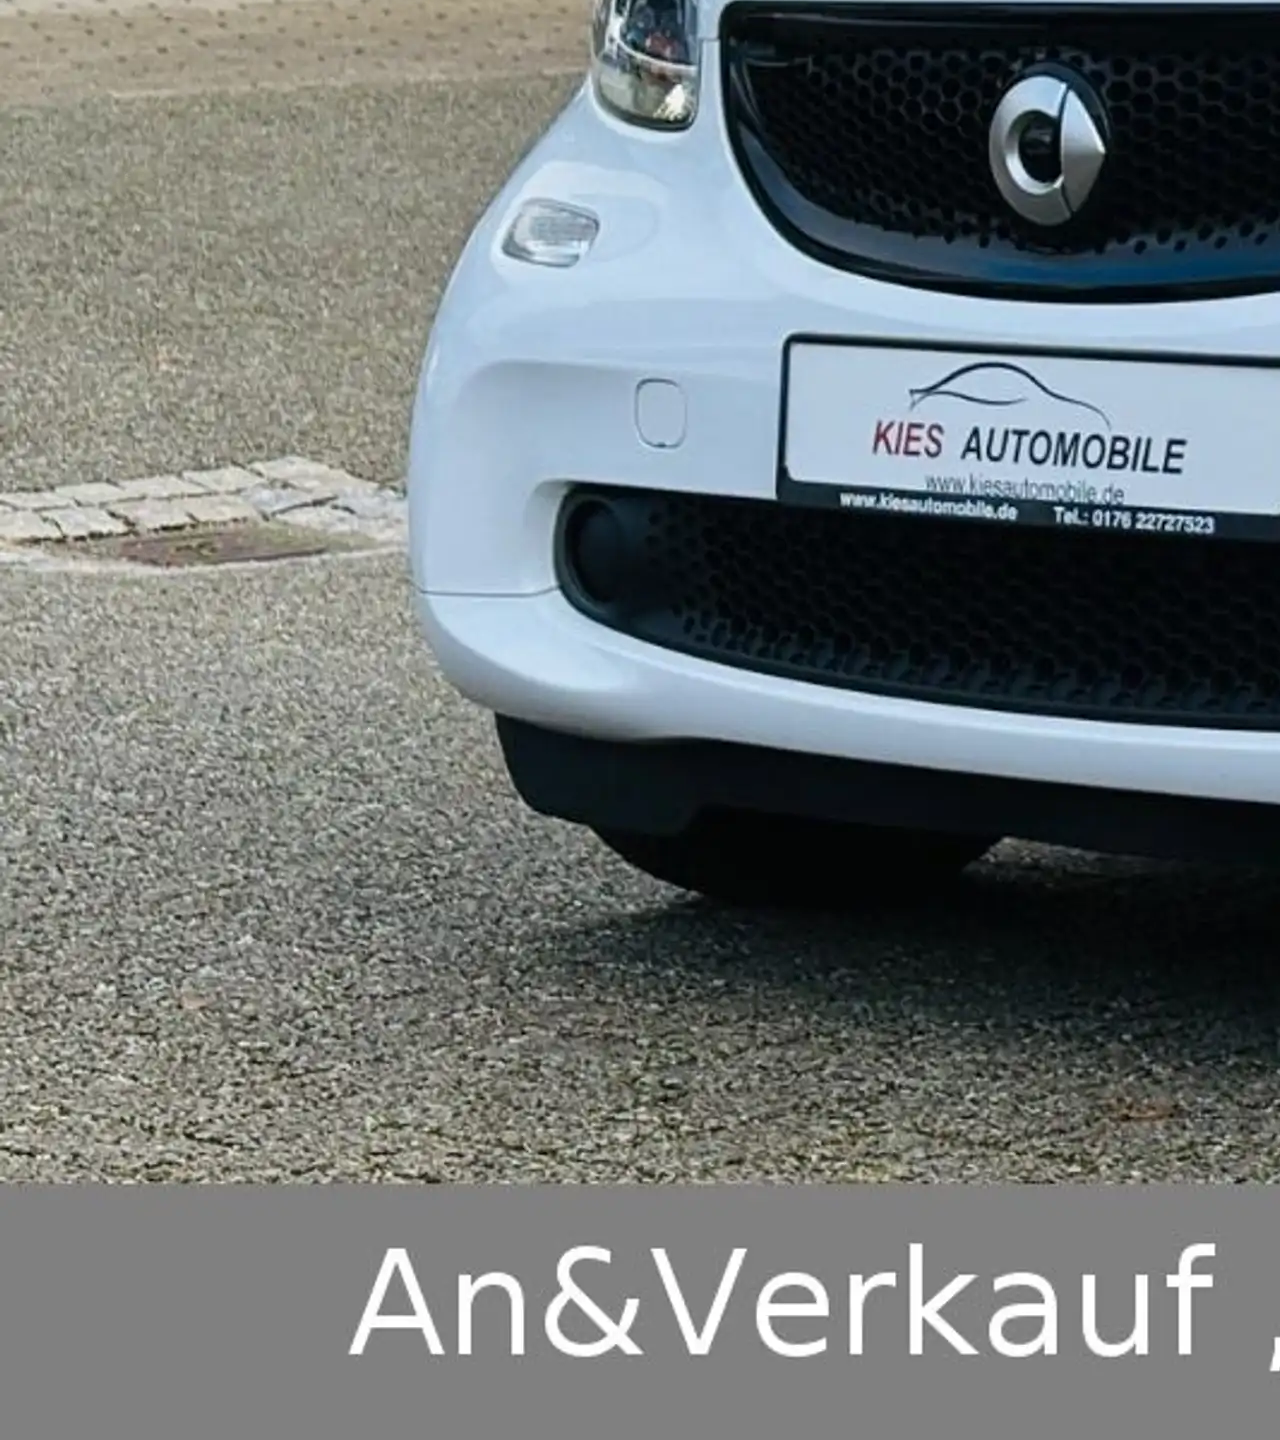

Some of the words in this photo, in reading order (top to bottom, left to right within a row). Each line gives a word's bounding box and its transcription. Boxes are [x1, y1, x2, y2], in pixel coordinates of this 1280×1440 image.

[872, 420, 945, 458] KIES
[961, 426, 1187, 474] AUTOMOBILE
[925, 473, 1125, 504] www.kiesautomobile.de
[840, 491, 1018, 521] www.kiesautomobile.de
[1092, 509, 1131, 529] 0176
